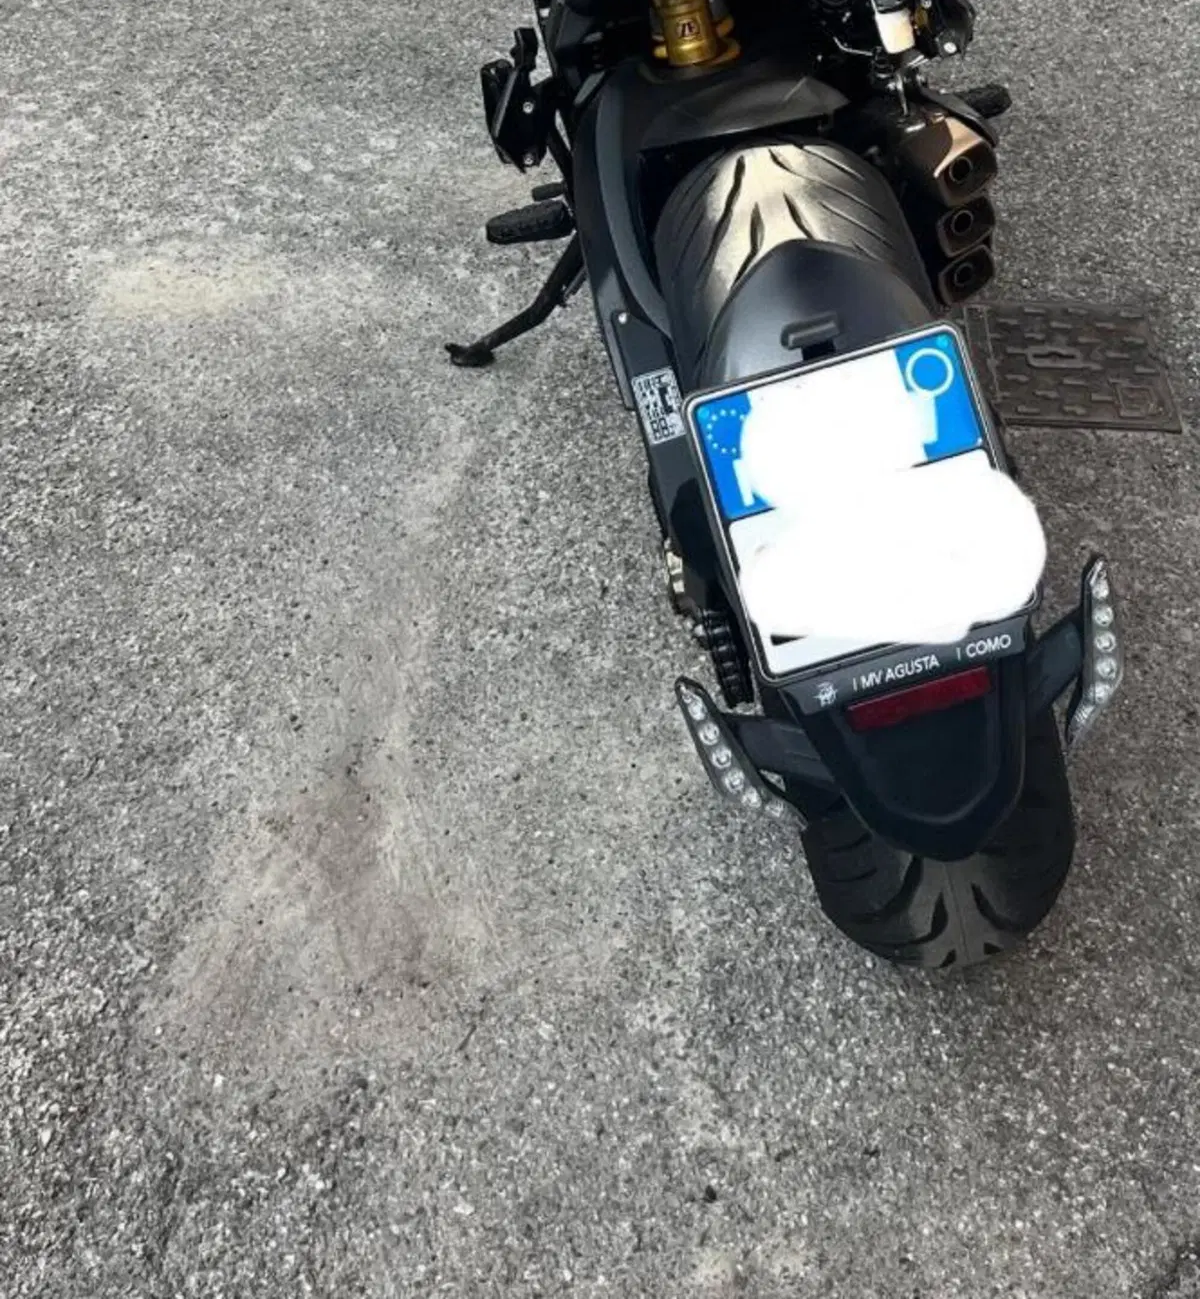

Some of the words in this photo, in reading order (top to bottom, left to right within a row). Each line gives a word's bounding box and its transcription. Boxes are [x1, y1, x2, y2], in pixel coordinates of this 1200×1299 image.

[861, 672, 882, 688] MV
[885, 654, 940, 683] AGUSTA
[965, 634, 1012, 658] COMO
